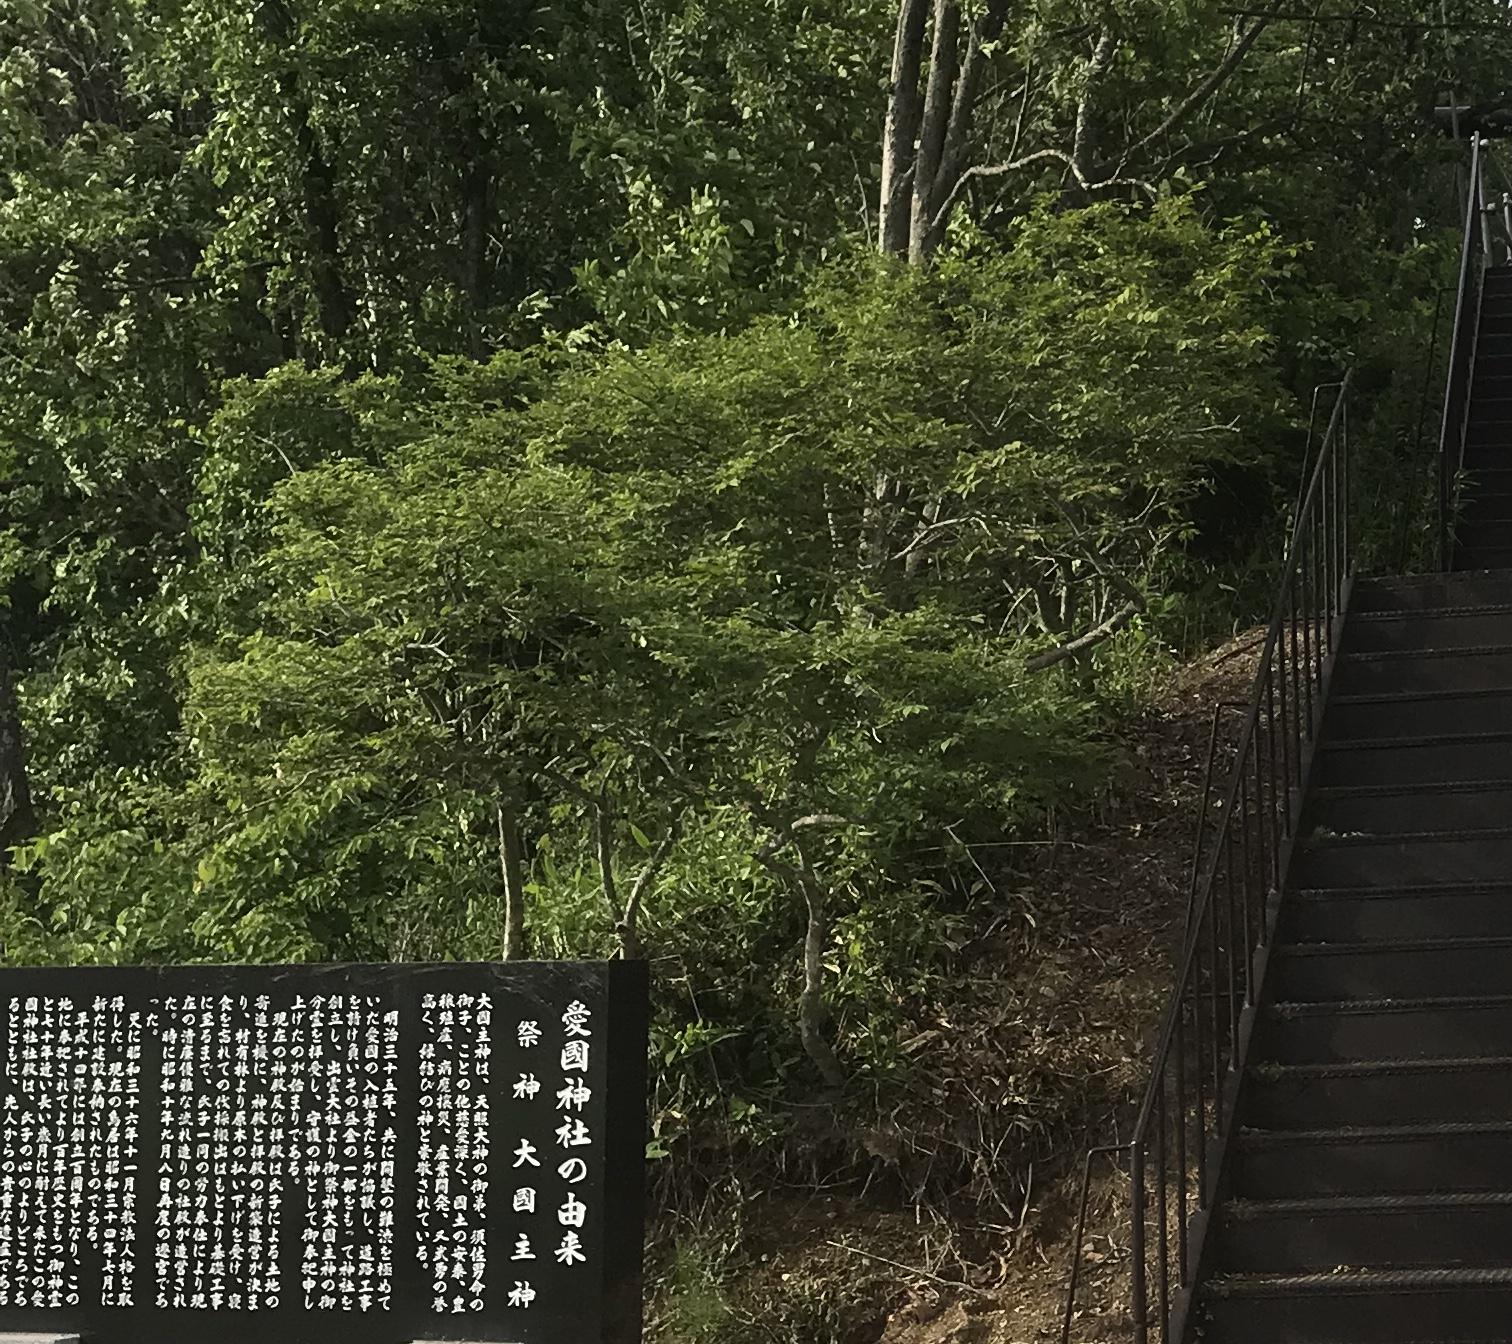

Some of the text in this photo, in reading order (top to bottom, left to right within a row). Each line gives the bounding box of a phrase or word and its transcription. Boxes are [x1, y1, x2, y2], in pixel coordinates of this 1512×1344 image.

[145, 998, 160, 1036] った。
[286, 994, 307, 1185] 上げたのが始まりである。
[553, 999, 592, 1266] 愛國神社の由来
